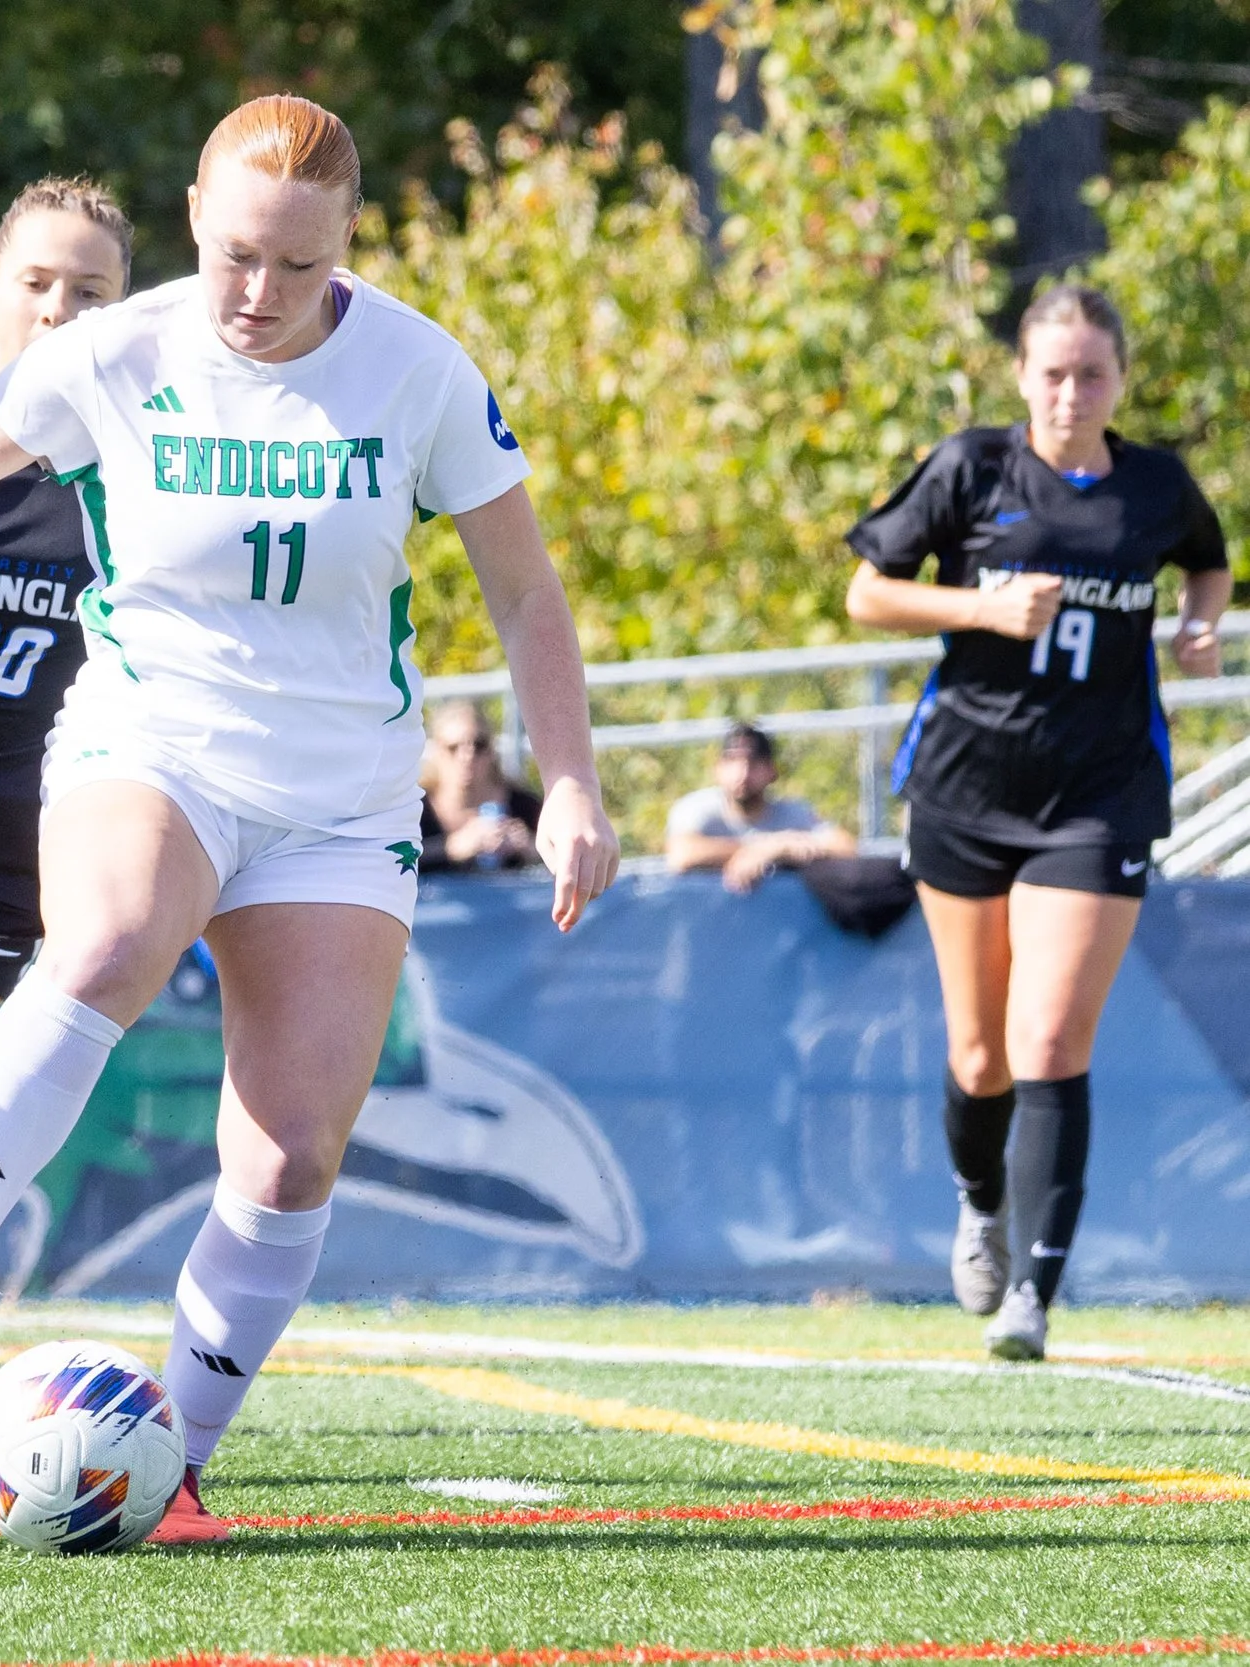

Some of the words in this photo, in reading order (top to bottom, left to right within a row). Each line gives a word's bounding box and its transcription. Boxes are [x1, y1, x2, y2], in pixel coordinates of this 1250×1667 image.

[152, 434, 384, 499] ENDICOTT
[243, 520, 307, 605] 11
[1061, 575, 1153, 613] NGLAND
[1030, 608, 1095, 682] 19
